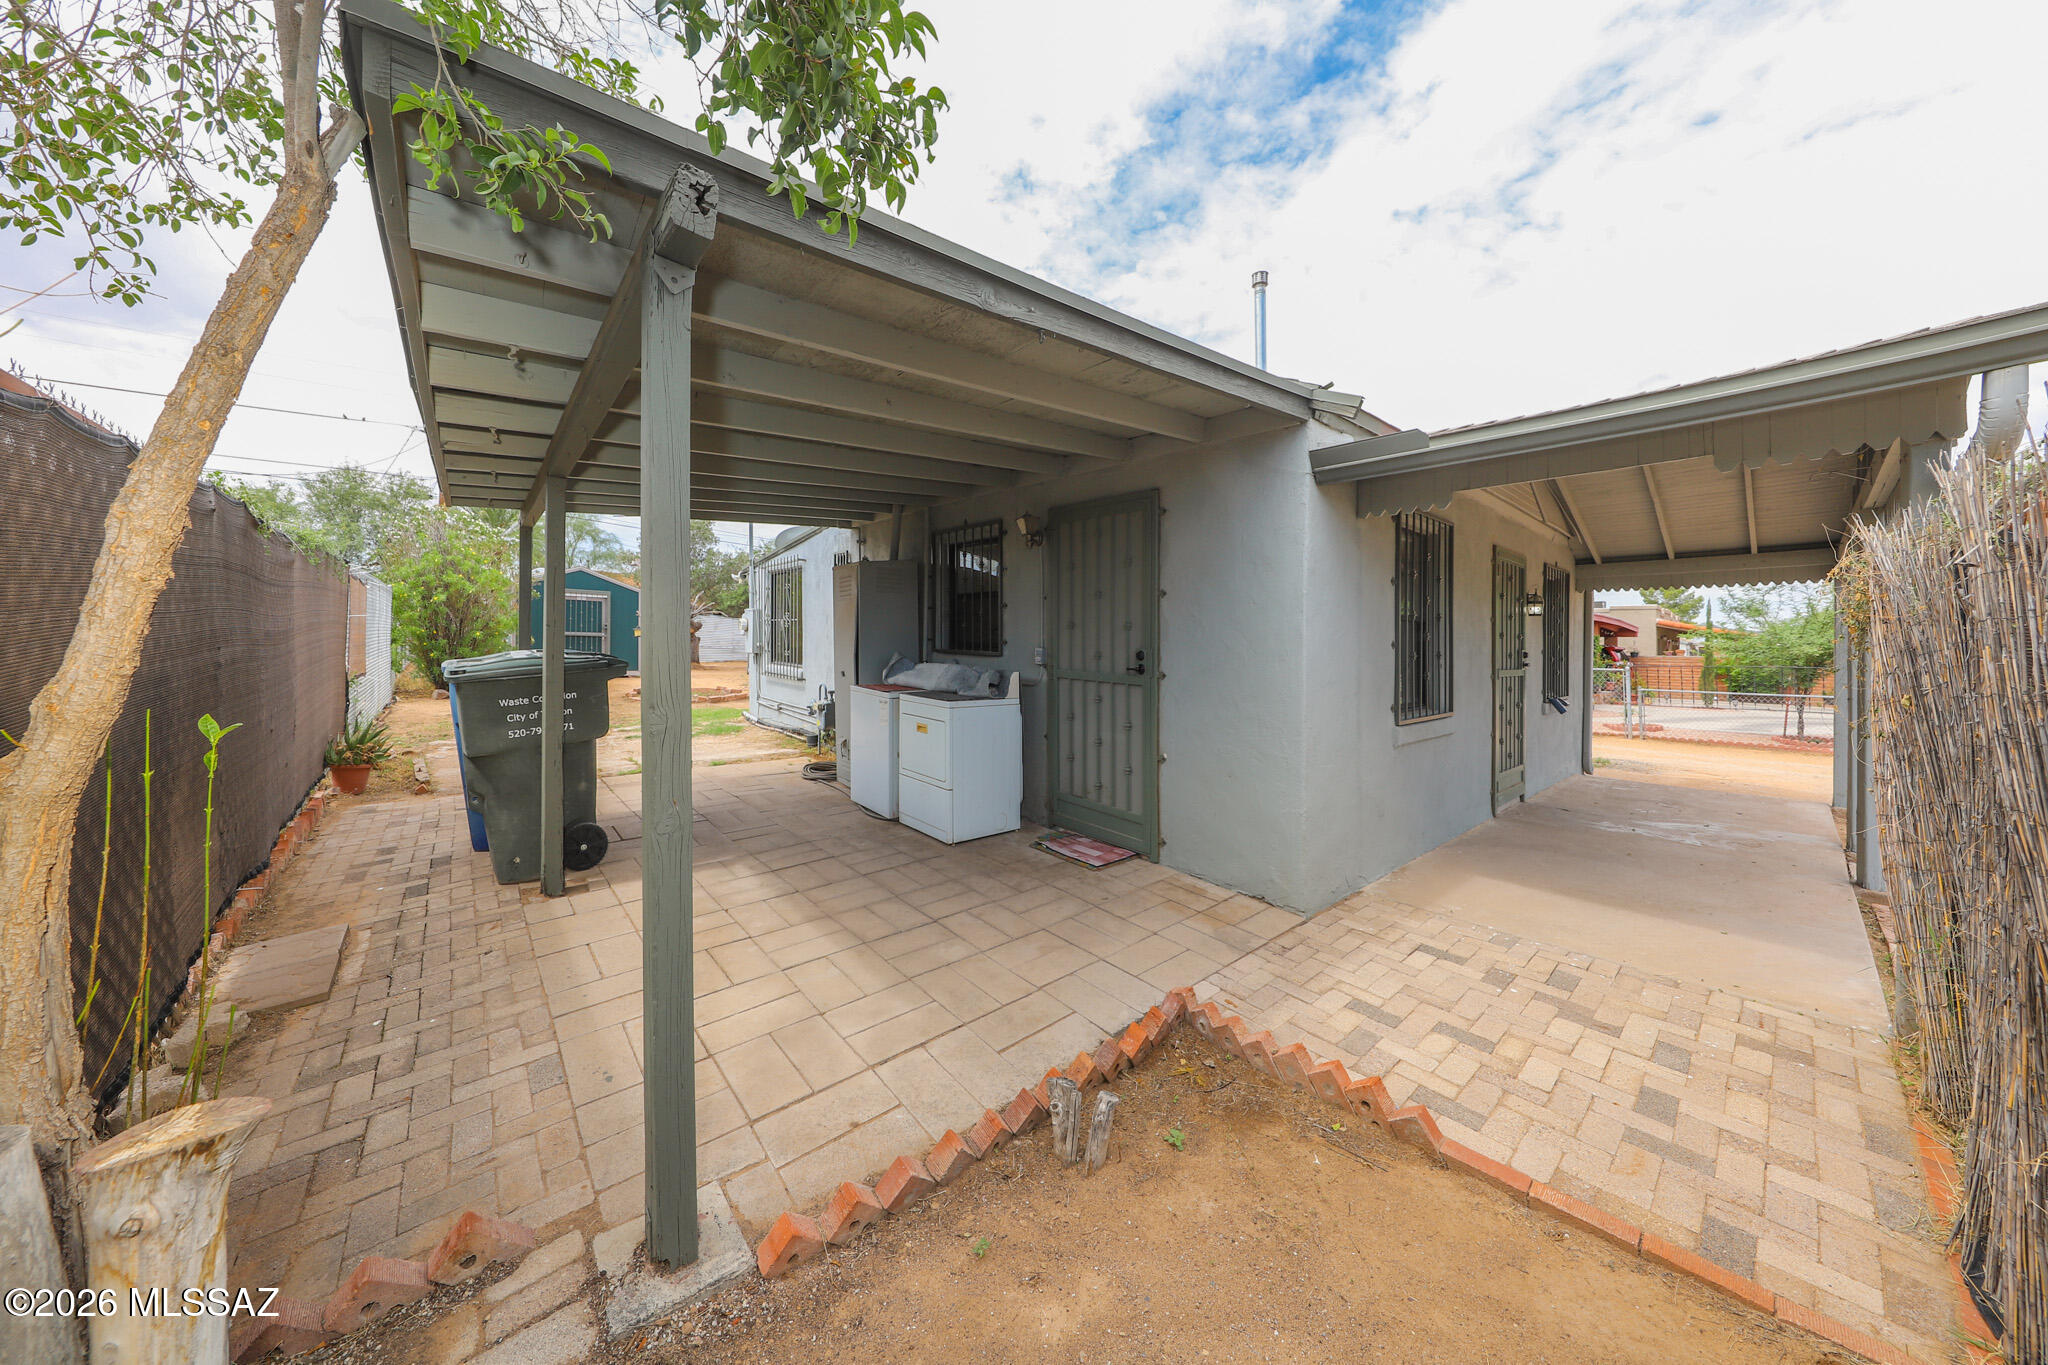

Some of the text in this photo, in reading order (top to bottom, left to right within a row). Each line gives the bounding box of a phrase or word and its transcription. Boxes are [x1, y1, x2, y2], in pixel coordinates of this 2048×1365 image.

[498, 692, 577, 707] Waste Coion
[506, 713, 526, 722] City
[529, 711, 539, 720] of
[508, 723, 574, 738] 520-7971
